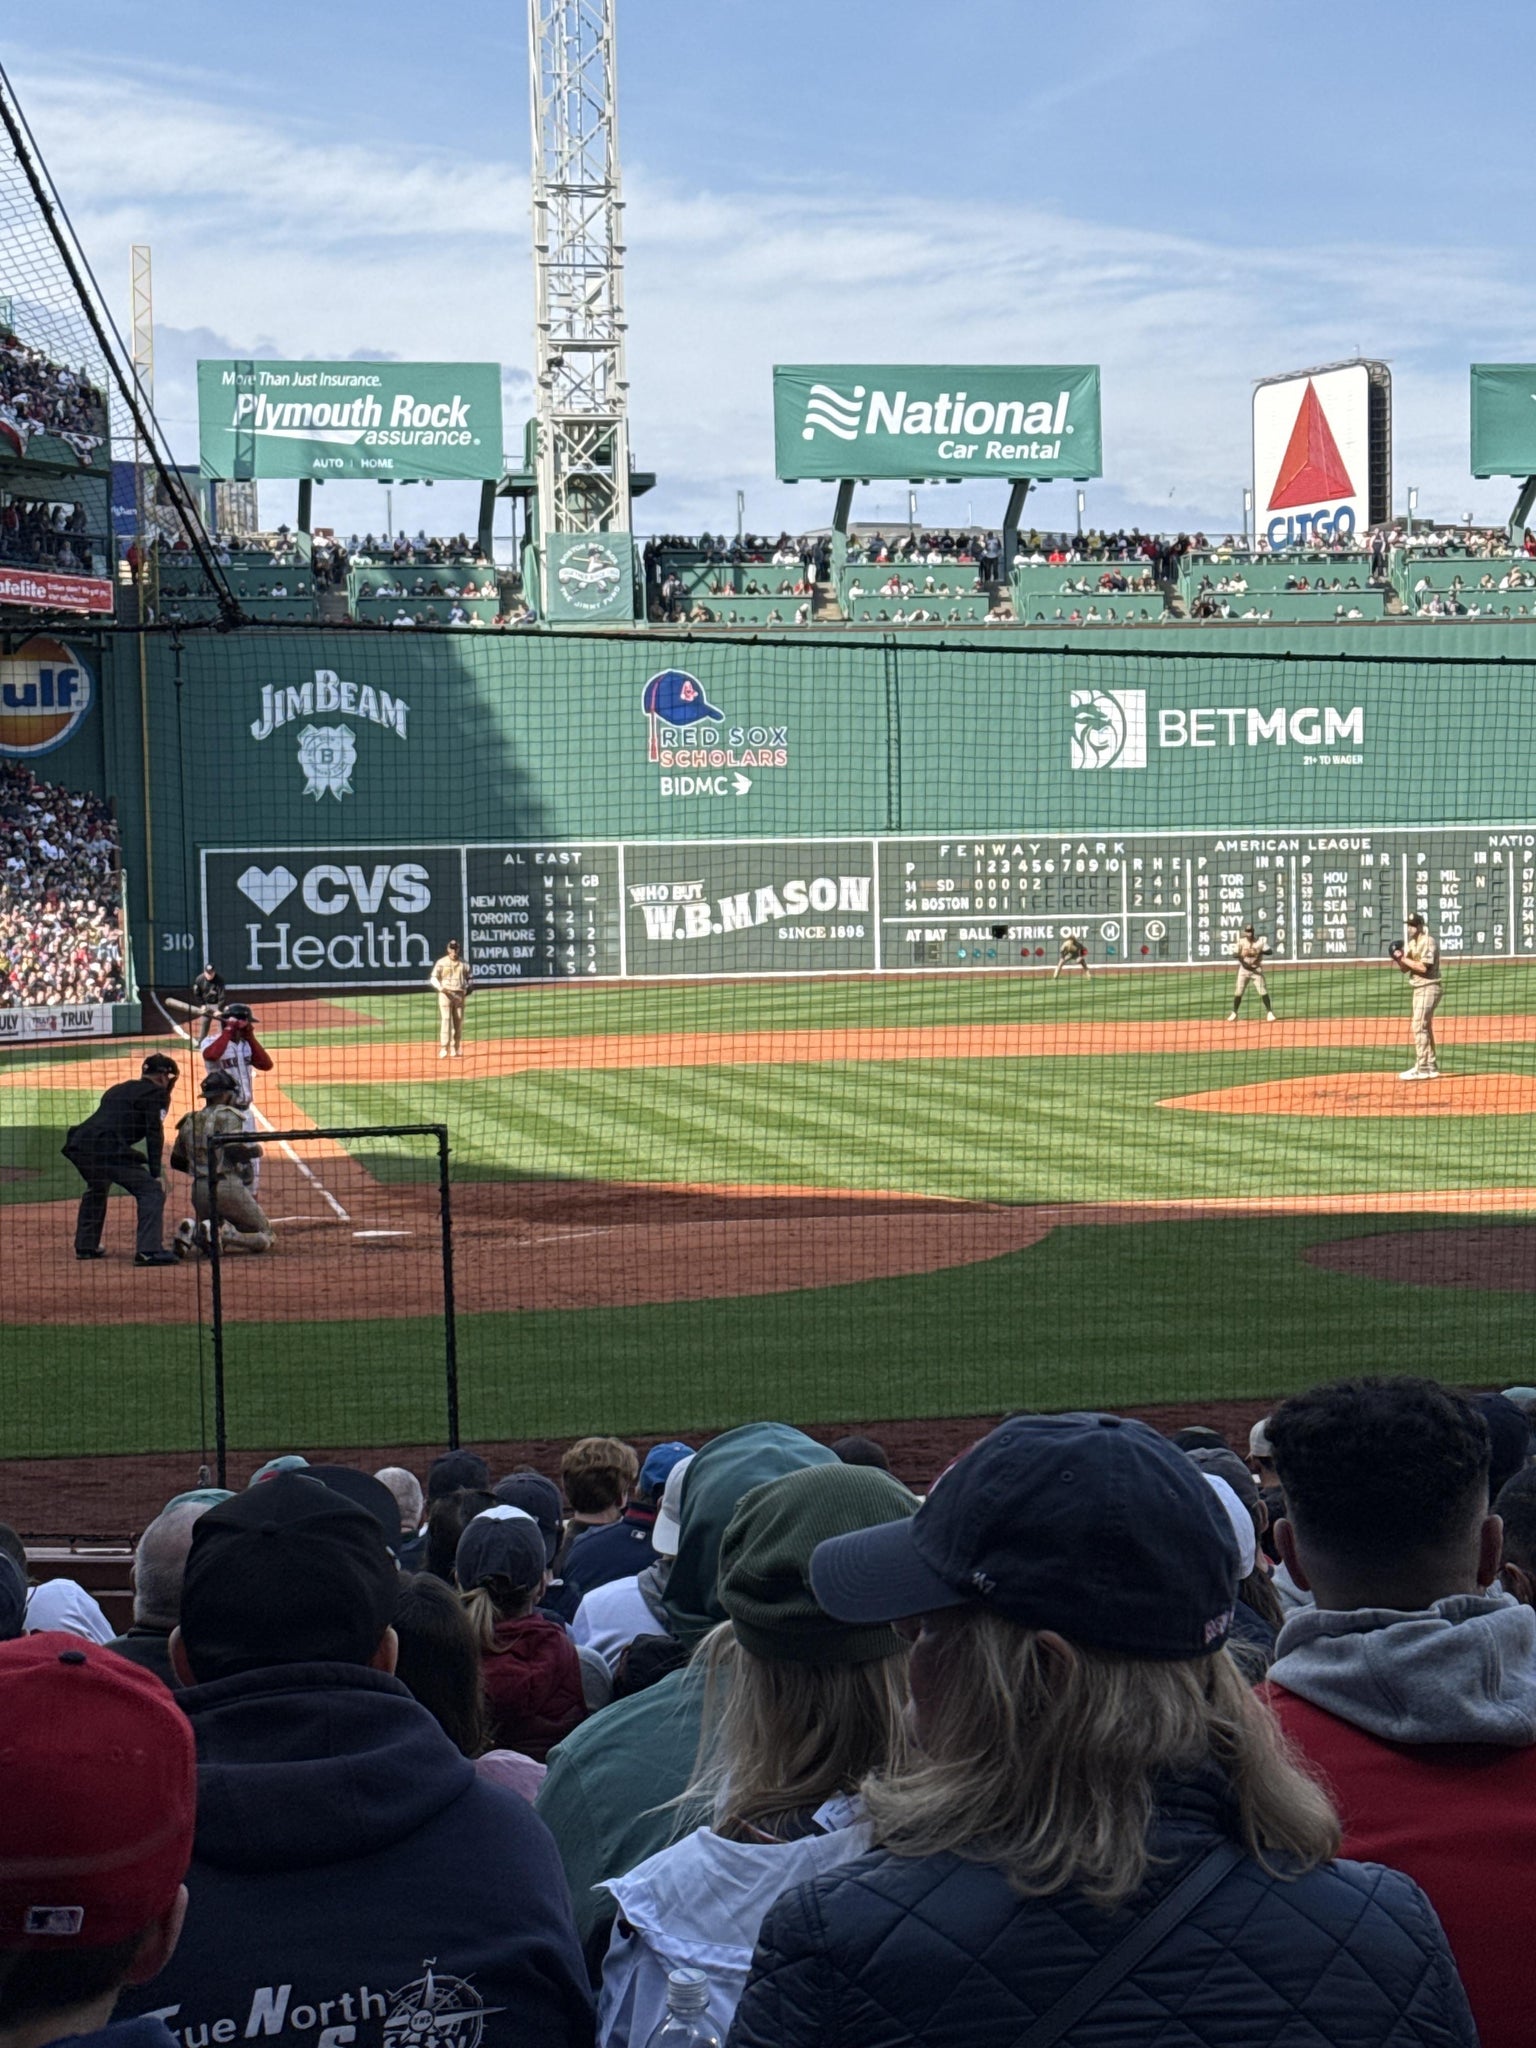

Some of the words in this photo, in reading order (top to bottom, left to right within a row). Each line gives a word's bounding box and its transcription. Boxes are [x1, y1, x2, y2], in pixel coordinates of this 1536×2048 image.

[222, 371, 256, 386] More
[259, 372, 290, 387] Than
[291, 372, 318, 387] Just
[320, 372, 382, 387] Insurance.
[232, 393, 382, 430] Plymouth
[390, 395, 471, 428] Rock
[865, 390, 1071, 435] National
[937, 441, 978, 459] Car
[986, 440, 1061, 459] Rental
[313, 458, 344, 468] AUTO
[361, 458, 393, 468] HOME
[1267, 505, 1355, 551] CITGO
[1158, 706, 1364, 747] BETMGM
[660, 727, 719, 747] RED
[729, 726, 788, 746] SOX
[660, 749, 787, 768] SCHOLARS
[660, 776, 728, 796] BIDMC
[1214, 839, 1299, 852] AMERICAN
[1308, 838, 1371, 851] LEAGUE
[1489, 835, 1535, 847] NATIO
[940, 843, 1040, 857] FENWAY
[1061, 842, 1125, 855] PARK
[1523, 850, 1533, 863] P
[503, 853, 525, 865] AL
[535, 852, 582, 865] EAST
[1198, 857, 1207, 869] P
[1255, 856, 1269, 868] IN
[1276, 856, 1284, 868] R
[1302, 855, 1312, 868] P
[1381, 853, 1390, 866] R
[1417, 852, 1426, 865] P
[1493, 851, 1503, 864] R
[906, 862, 915, 875] P
[987, 860, 996, 873] 2
[1001, 860, 1010, 873] 3
[1018, 859, 1028, 872] 4
[1032, 859, 1041, 873] 5
[1044, 859, 1055, 873] 6
[1062, 859, 1071, 872] 7
[1076, 859, 1085, 872] 8
[1088, 859, 1098, 872] 9
[1105, 858, 1119, 872] 10
[1133, 858, 1143, 870] R
[1153, 857, 1163, 870] H
[1172, 857, 1181, 870] E
[543, 875, 554, 888] W
[565, 875, 574, 888] L
[581, 875, 599, 888] GB
[936, 879, 955, 892] SD
[974, 879, 983, 890] 0
[988, 879, 996, 890] 0
[1001, 879, 1010, 890] 0
[1019, 878, 1028, 890] 0
[1032, 878, 1041, 890] 2
[1134, 876, 1143, 889] 2
[1153, 876, 1162, 888] 4
[1220, 874, 1244, 886] TOR
[1323, 872, 1348, 884] HOU
[1362, 879, 1372, 891] N
[302, 863, 432, 915] CVS
[629, 885, 669, 902] WHO
[672, 883, 703, 900] BUT
[1257, 880, 1267, 892] 5
[1324, 885, 1347, 898] ATH
[1442, 883, 1459, 895] KC
[1220, 888, 1245, 899] CWS
[470, 895, 495, 908] NEW
[498, 894, 530, 907] YORK
[545, 894, 553, 907] 5
[921, 897, 969, 911] BOSTON
[975, 897, 983, 909] 0
[988, 897, 997, 909] 0
[1134, 895, 1143, 906] 2
[1153, 894, 1162, 906] 4
[1173, 894, 1181, 906] 0
[1222, 902, 1242, 913] MIA
[1324, 900, 1347, 912] SEA
[1439, 897, 1462, 910] BAL
[471, 912, 529, 925] TORONTO
[545, 911, 554, 924] 4
[565, 911, 574, 923] 2
[1258, 907, 1267, 919] 6
[1324, 913, 1347, 925] LAA
[1362, 906, 1373, 918] N
[1441, 911, 1460, 923] PIT
[1220, 916, 1244, 927] NYY
[471, 929, 536, 942] BALTIMORE
[546, 928, 555, 941] 3
[566, 928, 575, 941] 3
[587, 927, 596, 940] 2
[779, 926, 827, 940] SINCE
[830, 925, 865, 939] 1898
[906, 929, 922, 941] AT
[924, 929, 948, 941] BAT
[959, 928, 993, 940] BALL
[1008, 926, 1054, 940] STRIKE
[1060, 926, 1089, 939] OUT
[1328, 928, 1345, 939] TB
[1439, 925, 1463, 937] LAD
[162, 933, 195, 951] 310
[245, 921, 434, 971] Health
[1325, 942, 1348, 953] MIN
[1494, 938, 1503, 950] 5
[471, 947, 509, 959] TAMPA
[513, 946, 535, 958] BAY
[546, 945, 555, 958] 2
[566, 944, 575, 957] 4
[587, 944, 596, 957] 3
[472, 963, 522, 976] BOSTON
[567, 962, 576, 974] 5
[587, 960, 597, 973] 4
[61, 1010, 94, 1027] TRULY
[138, 2003, 237, 2048] Tue
[245, 1984, 386, 2038] North
